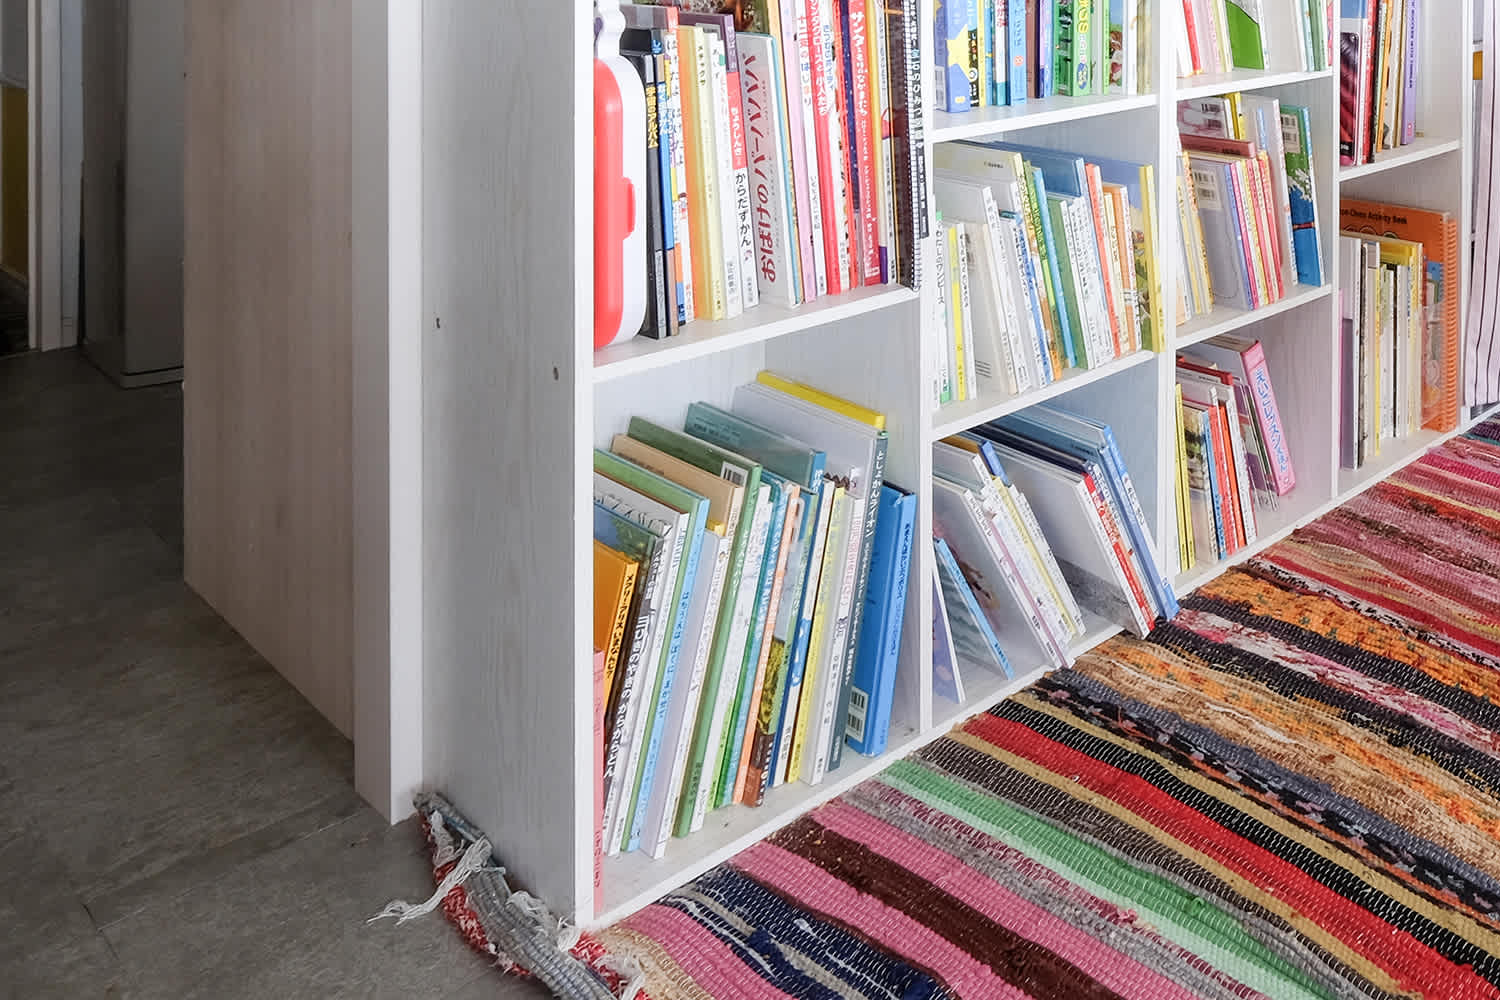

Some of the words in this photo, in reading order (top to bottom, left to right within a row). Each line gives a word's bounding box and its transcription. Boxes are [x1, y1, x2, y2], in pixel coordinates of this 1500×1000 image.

[736, 173, 752, 247] からだずかん
[742, 52, 776, 283] おばけのバーバパパ
[865, 451, 884, 537] としょかんライオン
